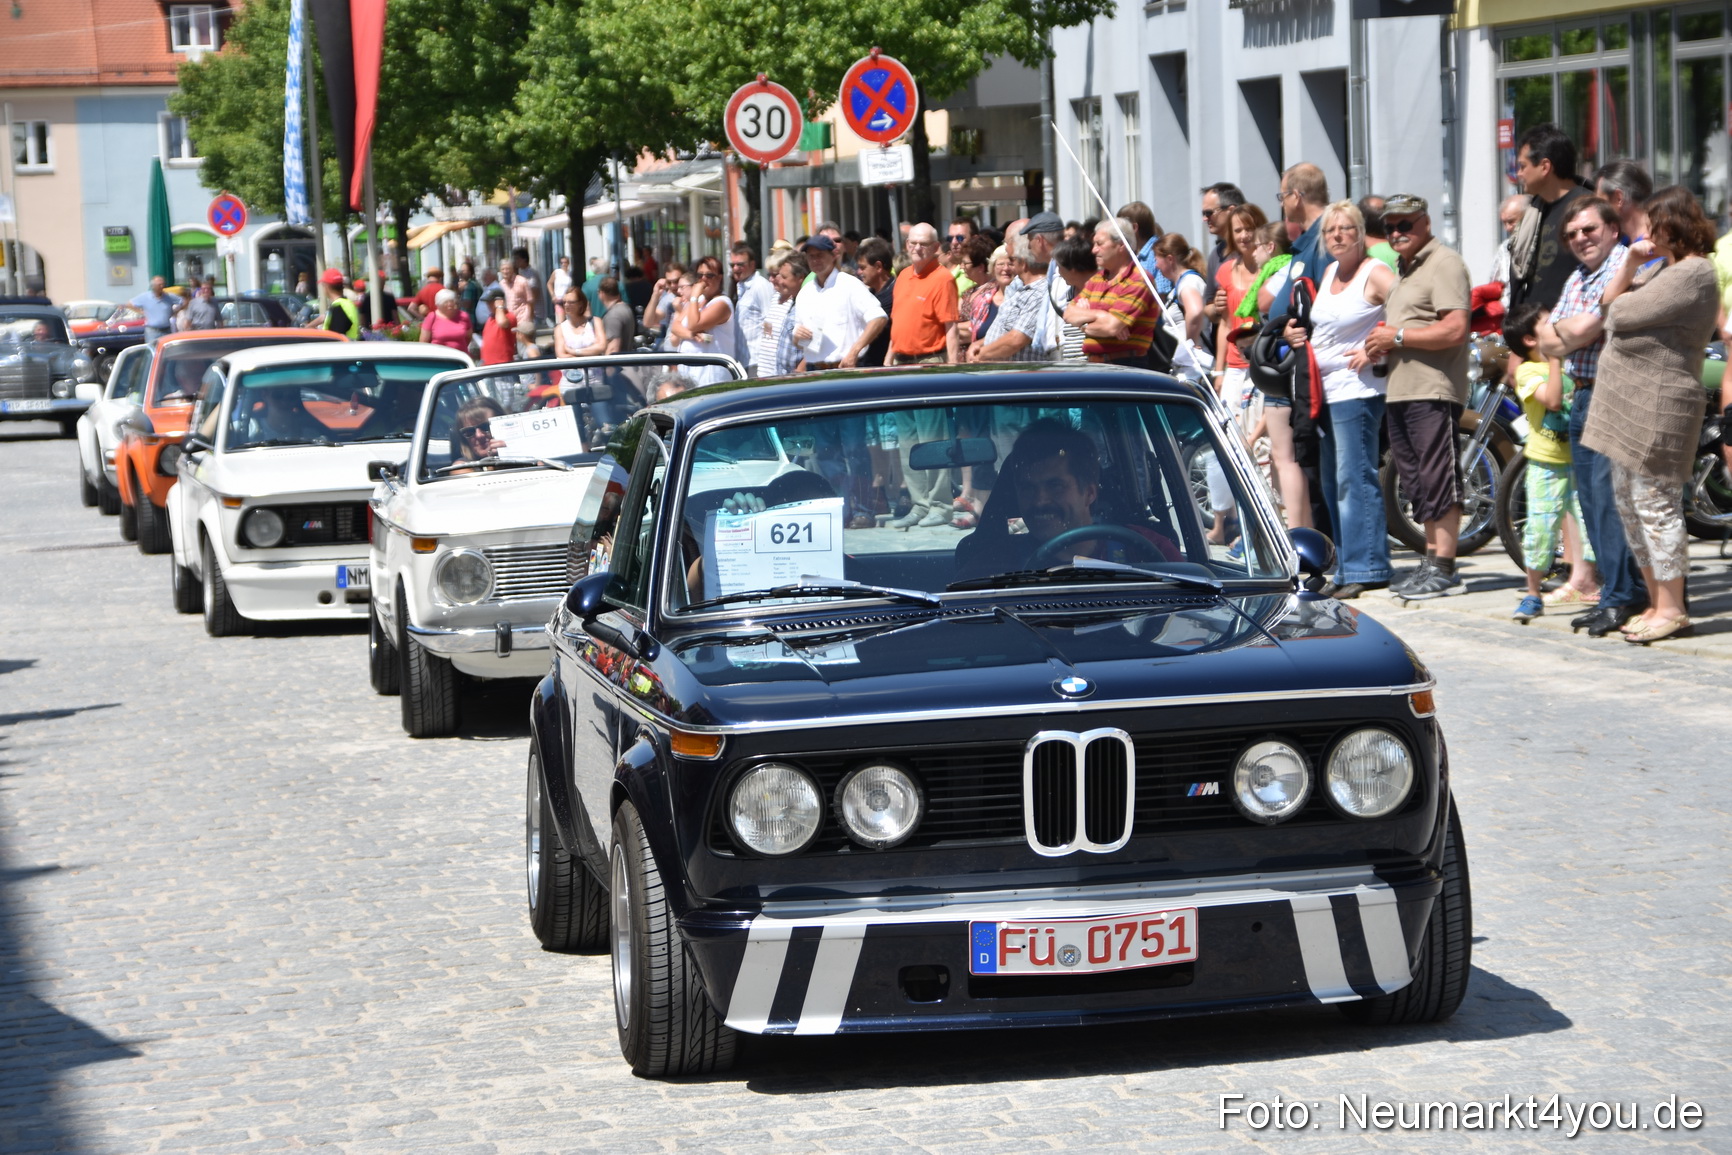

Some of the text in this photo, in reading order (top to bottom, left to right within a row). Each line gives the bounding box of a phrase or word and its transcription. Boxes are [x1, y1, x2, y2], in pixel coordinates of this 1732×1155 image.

[742, 103, 785, 140] 30
[532, 417, 558, 431] 651
[770, 521, 814, 545] 621
[347, 567, 369, 585] NM
[998, 915, 1192, 967] FÜ 0751
[979, 952, 989, 964] D
